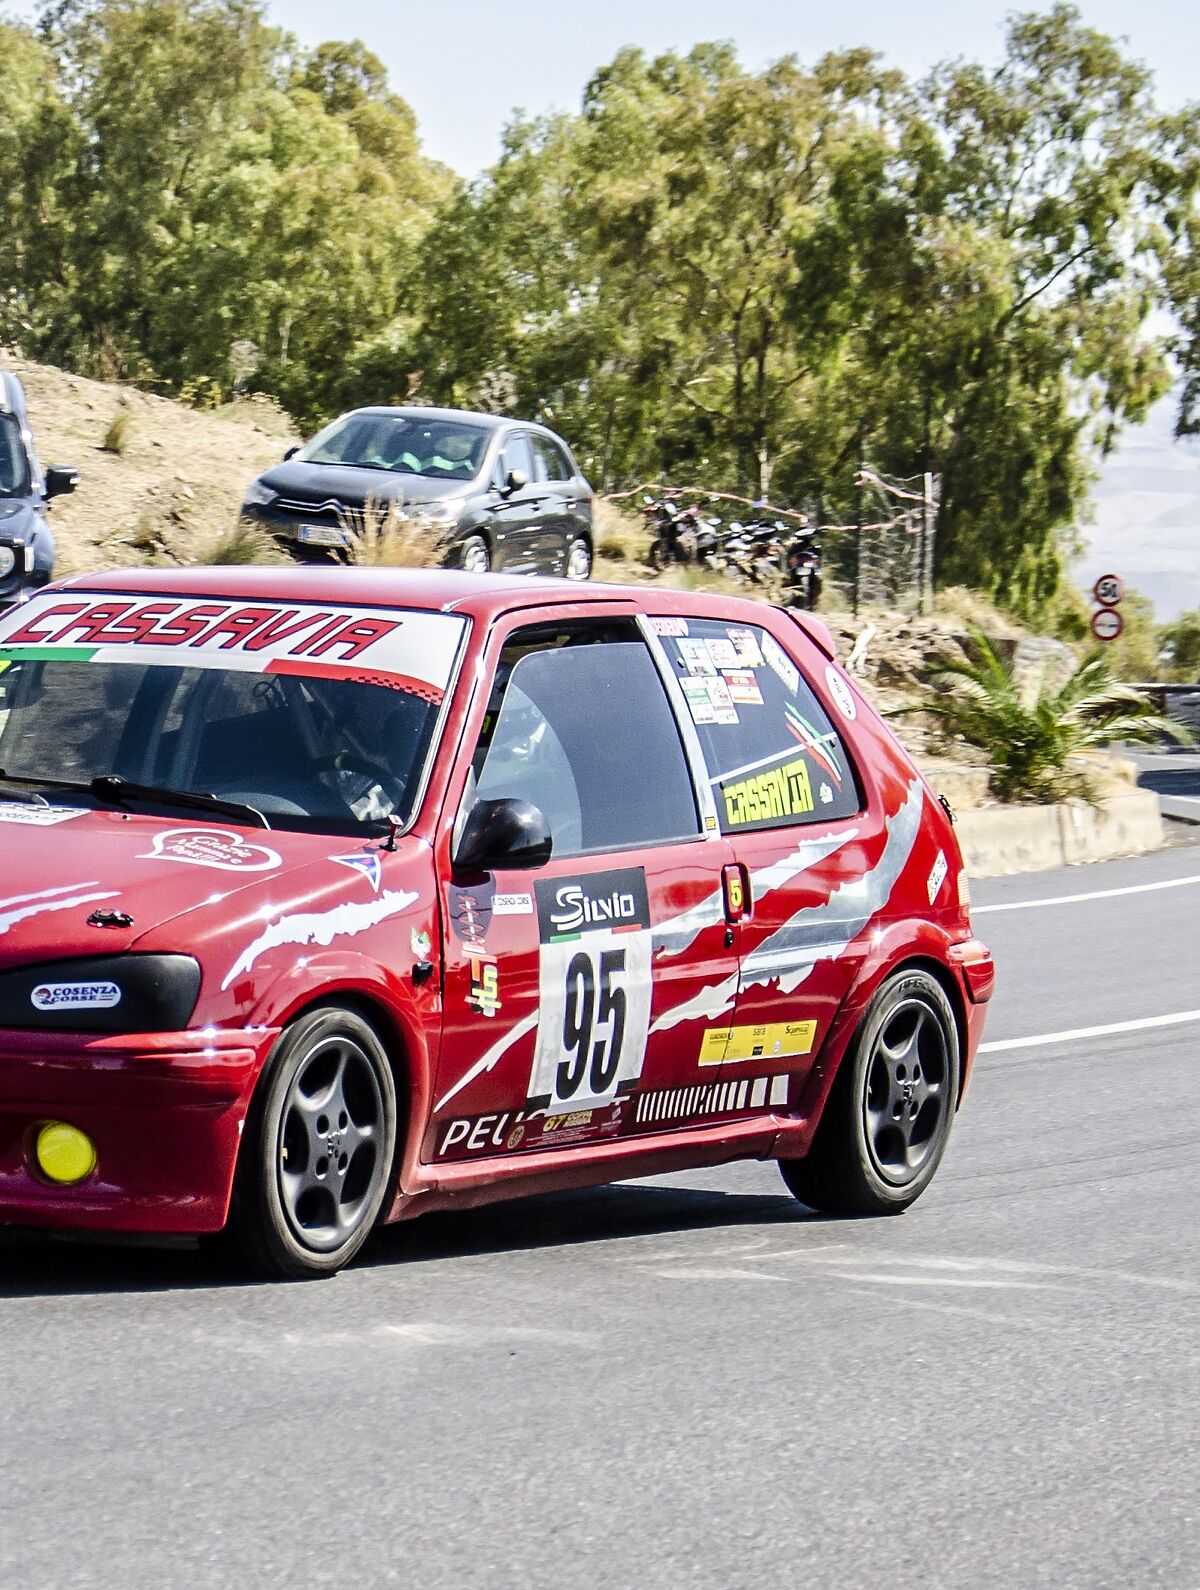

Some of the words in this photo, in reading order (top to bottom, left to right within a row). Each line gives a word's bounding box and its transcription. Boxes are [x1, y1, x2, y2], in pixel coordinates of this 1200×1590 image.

[0, 602, 402, 659] CASSAVIA
[724, 759, 814, 825] CASSAVIA
[729, 879, 742, 907] 5
[51, 995, 97, 1003] CORSE
[53, 986, 118, 996] COSENZA
[556, 949, 626, 1101] 95
[543, 1114, 569, 1132] 67
